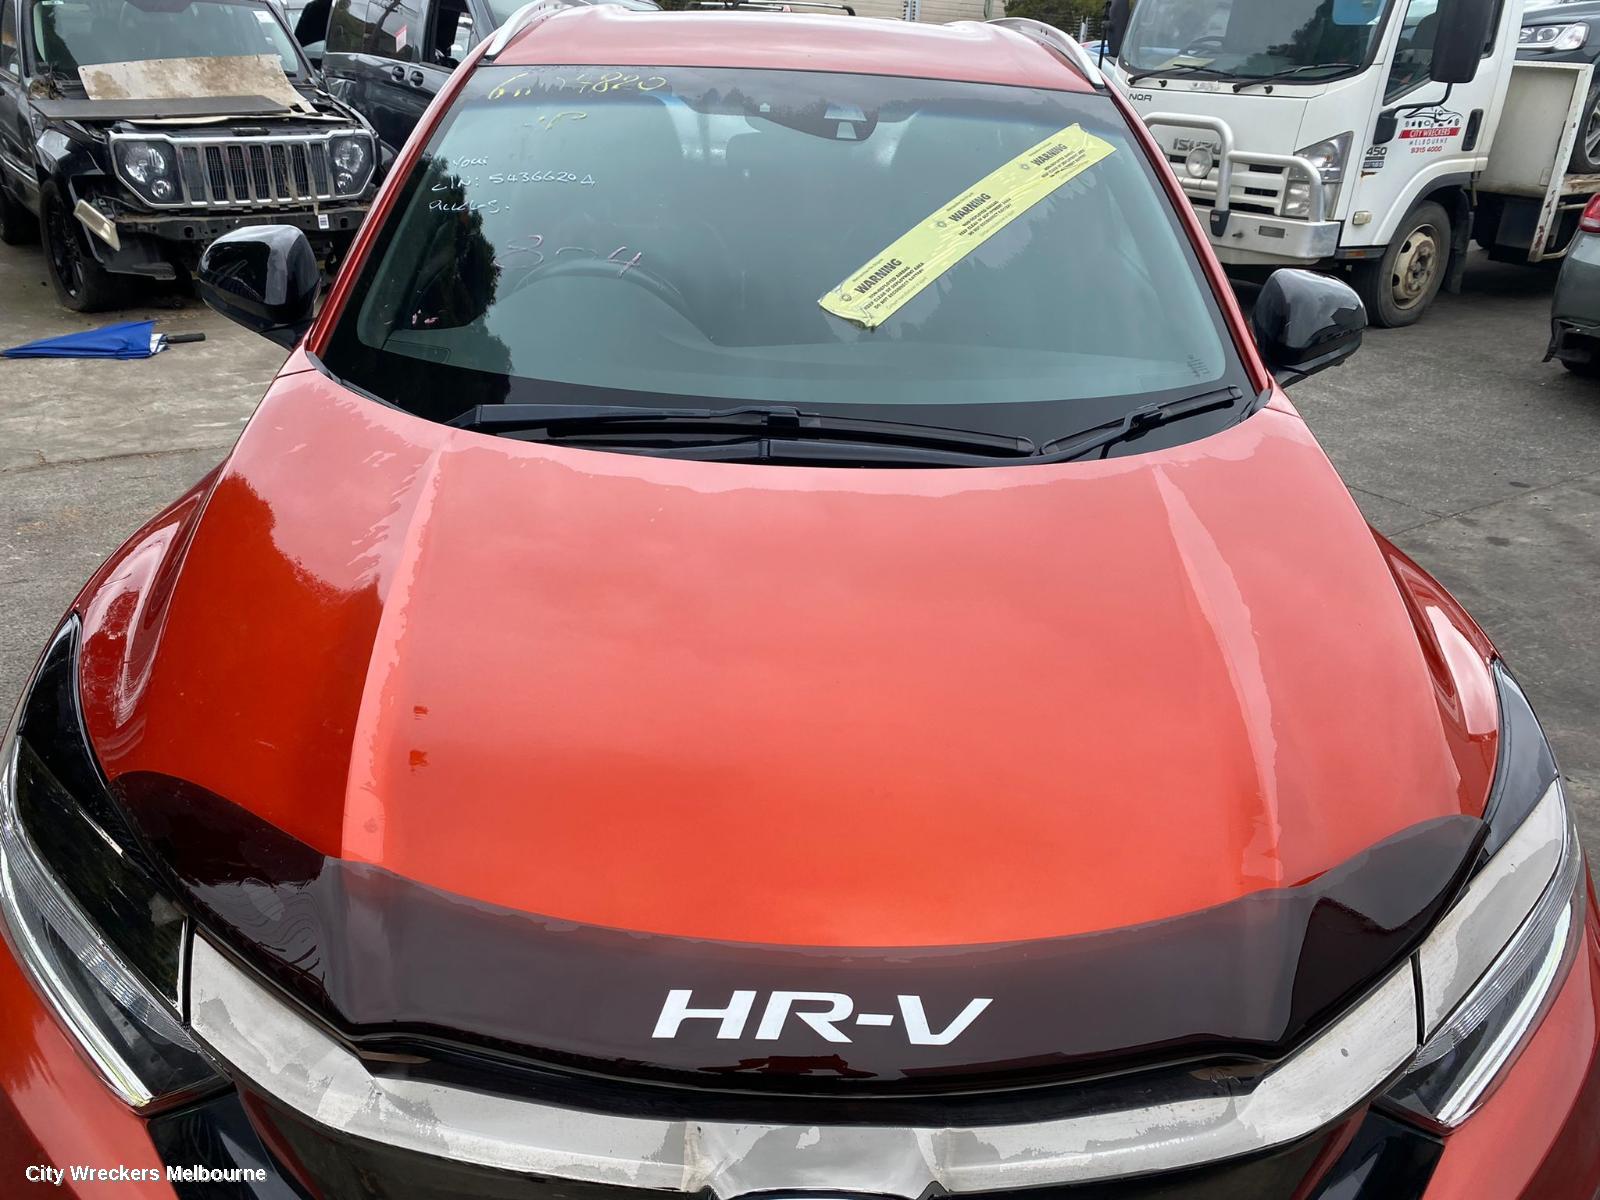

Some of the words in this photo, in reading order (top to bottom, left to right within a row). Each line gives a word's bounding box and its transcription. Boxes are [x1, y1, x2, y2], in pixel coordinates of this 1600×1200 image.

[1128, 93, 1153, 102] NQR
[1409, 130, 1422, 138] CITY
[1423, 128, 1451, 137] WRECKERS
[1031, 143, 1067, 166] WARNING
[1366, 146, 1388, 156] 450
[949, 193, 991, 222] WARNING
[855, 259, 902, 293] WARNING
[651, 989, 993, 1046] HR-V
